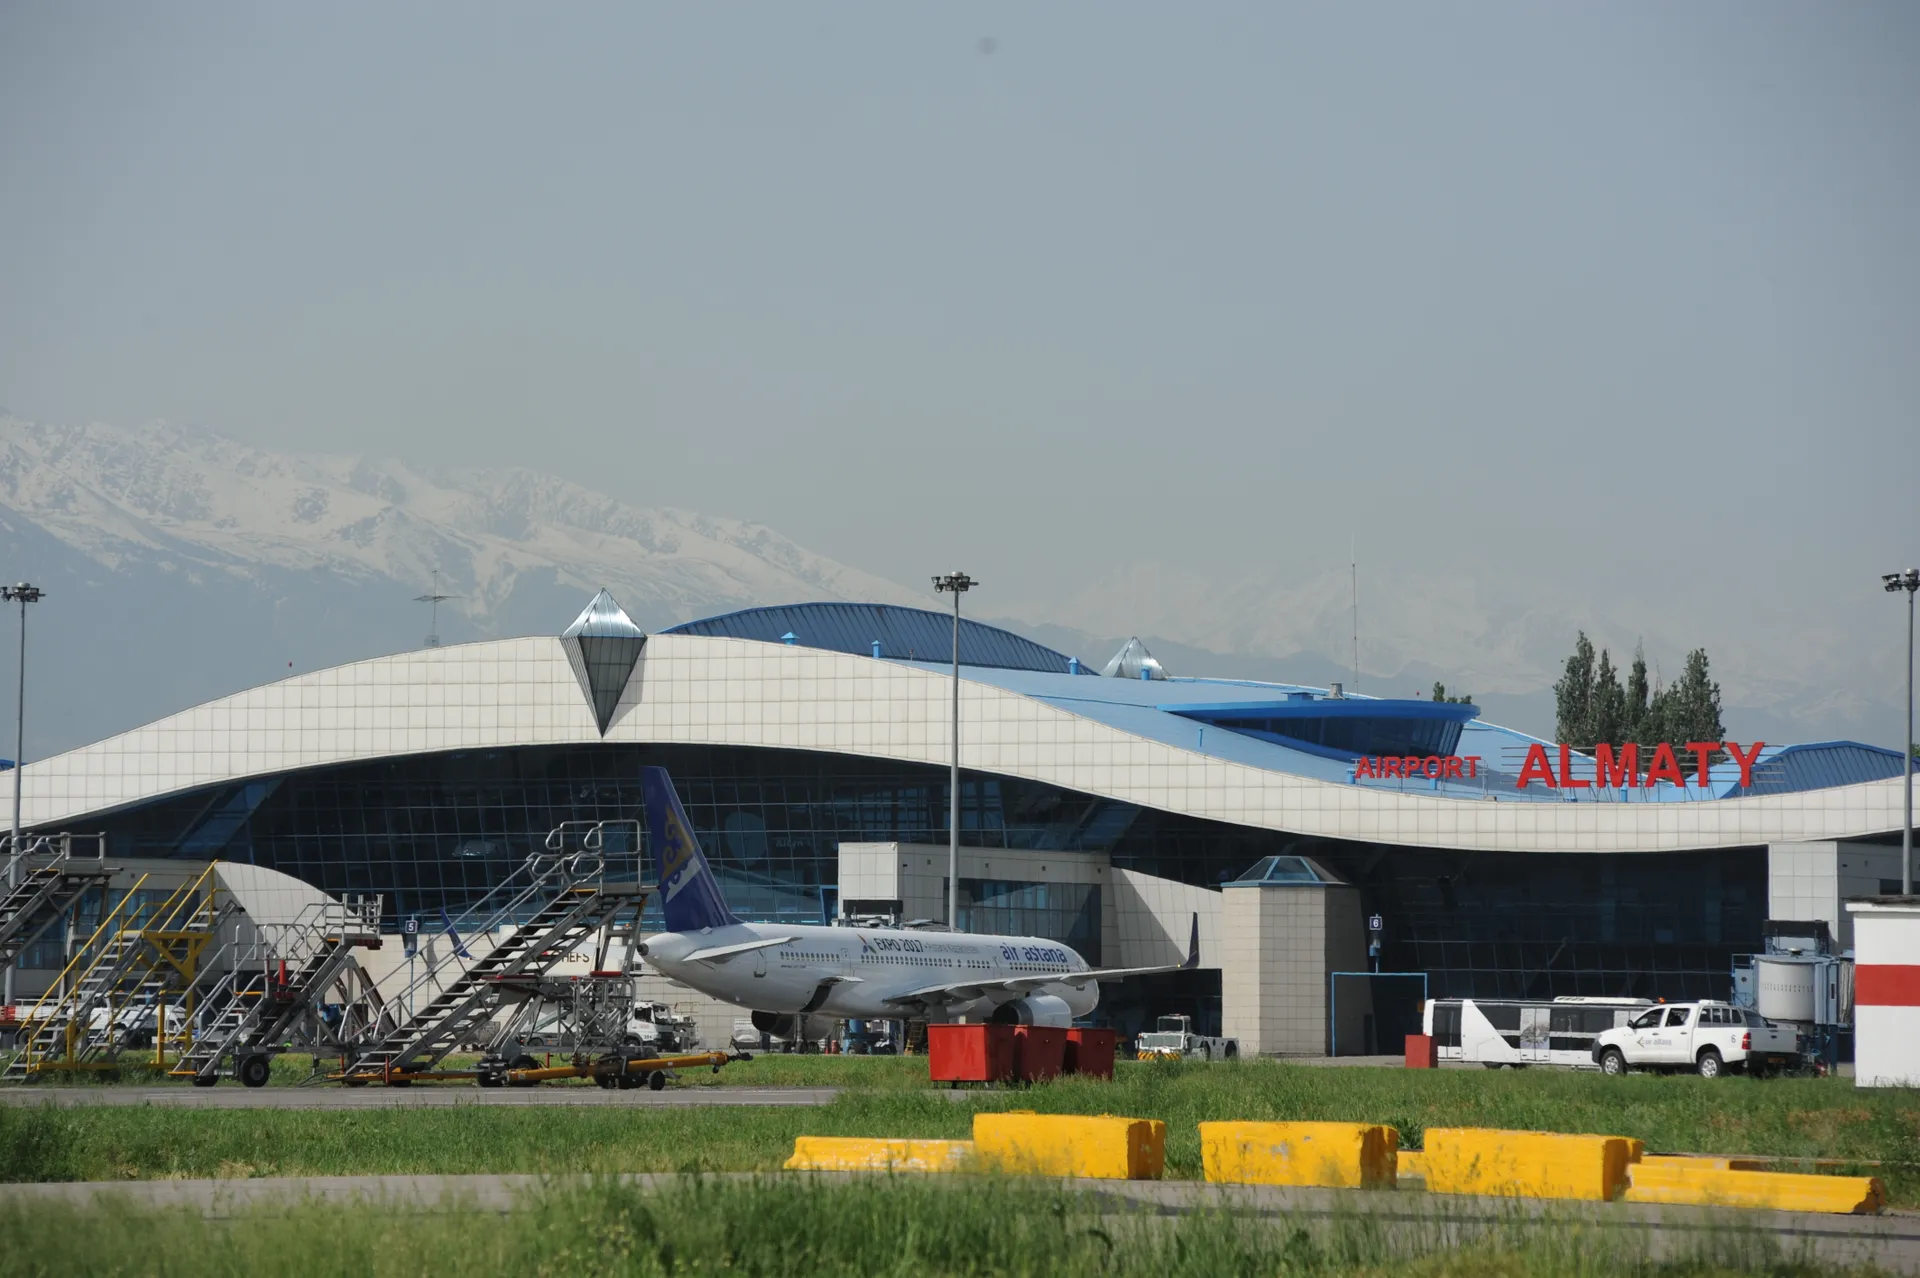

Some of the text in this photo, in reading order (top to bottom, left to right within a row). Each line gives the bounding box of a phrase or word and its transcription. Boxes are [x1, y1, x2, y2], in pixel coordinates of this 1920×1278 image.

[1355, 741, 1766, 788] AIRPORT ALMATY
[408, 922, 414, 931] 5
[1373, 918, 1379, 928] 6
[874, 938, 901, 951] EXPO
[902, 939, 924, 953] 2017
[553, 950, 590, 963] HEFS
[1000, 942, 1068, 963] air astana
[1731, 1034, 1736, 1044] 6
